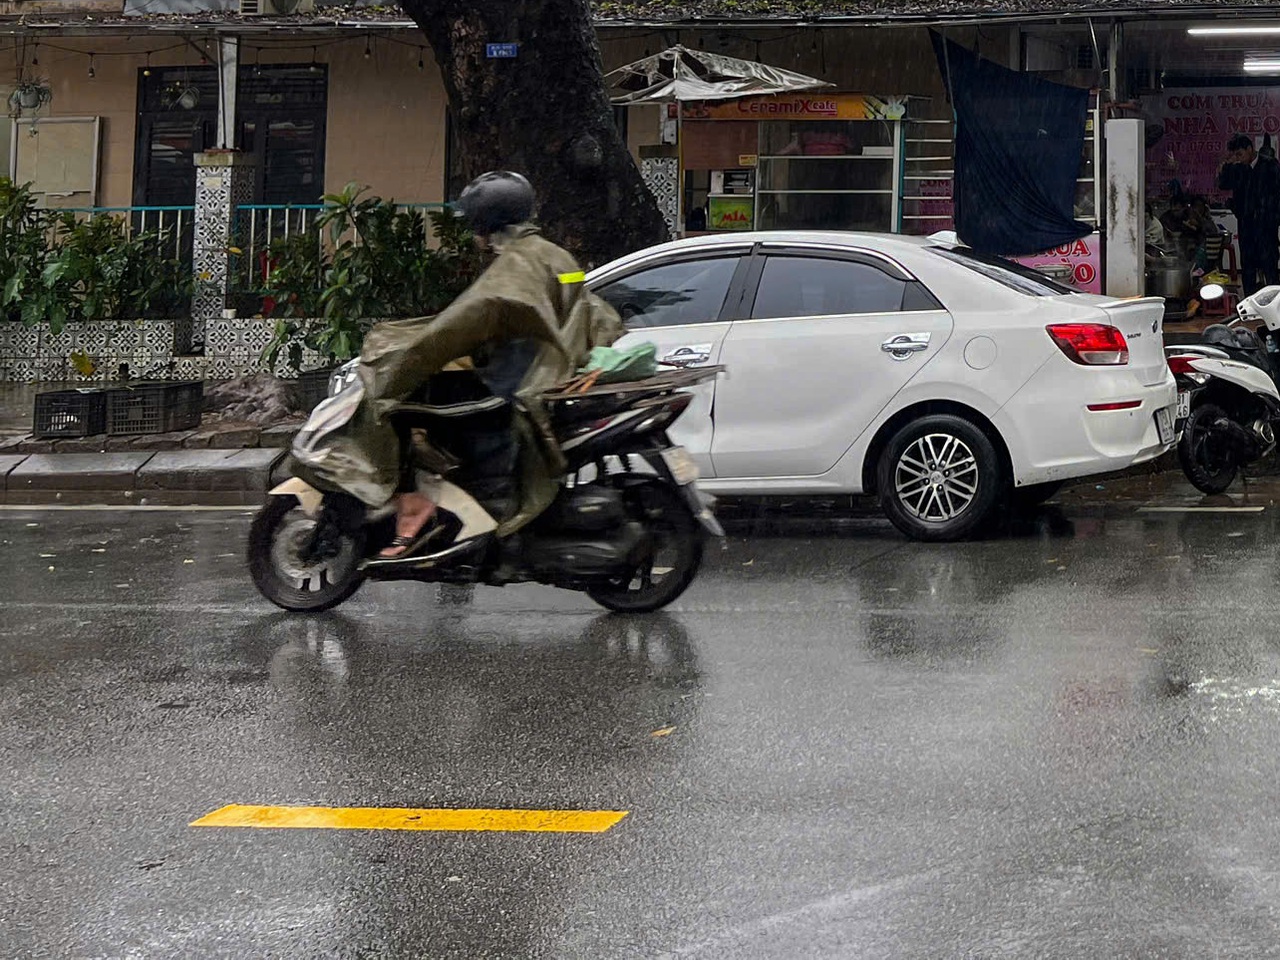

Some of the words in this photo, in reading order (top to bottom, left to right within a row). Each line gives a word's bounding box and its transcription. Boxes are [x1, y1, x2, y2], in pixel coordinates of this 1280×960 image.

[1167, 92, 1212, 110] CƠM
[1217, 92, 1275, 109] TRƯA
[1163, 112, 1220, 134] NHÀ
[1227, 112, 1280, 133] MÈO
